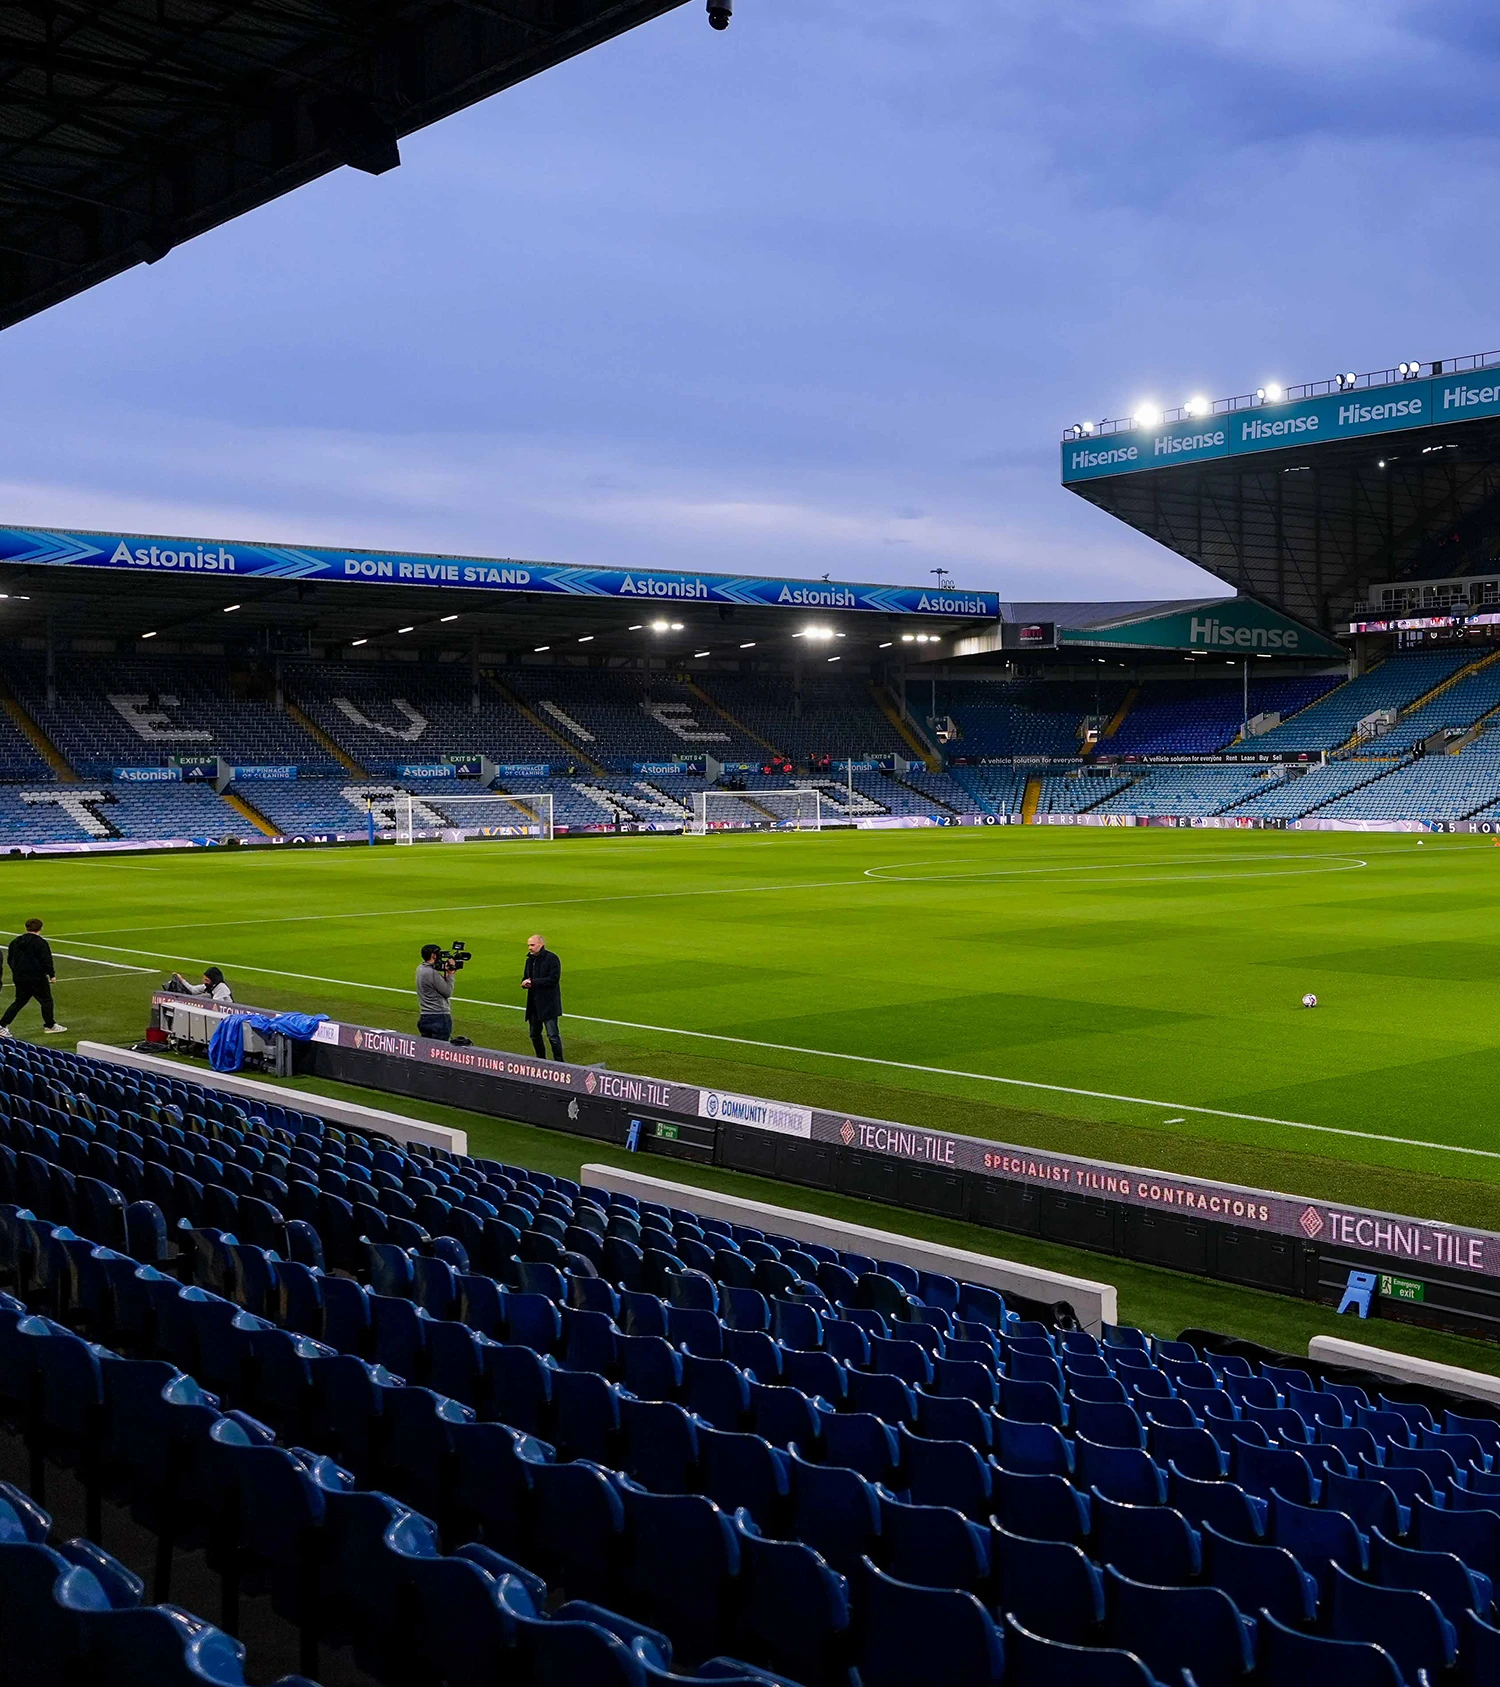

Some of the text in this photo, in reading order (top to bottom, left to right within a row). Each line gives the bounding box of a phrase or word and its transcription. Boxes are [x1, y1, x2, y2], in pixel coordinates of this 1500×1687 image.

[1338, 398, 1423, 426] Hisense
[1242, 413, 1319, 441] Hisense
[1154, 429, 1225, 456] Hisense
[1071, 444, 1138, 470] Hisense
[110, 541, 235, 571] Astonish
[344, 559, 530, 585] DON REVIE STAND
[620, 574, 708, 599] Astonish
[778, 584, 856, 607] Astonish
[917, 593, 987, 614] Astonish
[1189, 617, 1299, 649] Hisense
[1381, 616, 1479, 629] LEEDS UNITED
[640, 765, 680, 774] Astonish
[1053, 757, 1083, 765] everyone
[1259, 754, 1269, 762] Buy
[119, 769, 176, 780] Astonish
[403, 766, 450, 777] Astonish
[1036, 814, 1091, 825] JERSEY
[1168, 817, 1220, 829] LEEDS
[1406, 822, 1456, 834] 24/25
[364, 1032, 572, 1084] TECHNI-TILE SPECIALIST TILING CONTRACTORS
[599, 1076, 670, 1107] TECHNI-TILE
[721, 1099, 767, 1122] COMMUNITY
[858, 1124, 956, 1164] TECHNI-TILE
[983, 1152, 1270, 1223] SPECIALIST TILING CONTRACTORS
[1328, 1211, 1485, 1270] TECHNI-TILE
[1393, 1278, 1421, 1291] Emergency
[1399, 1288, 1415, 1299] exit
